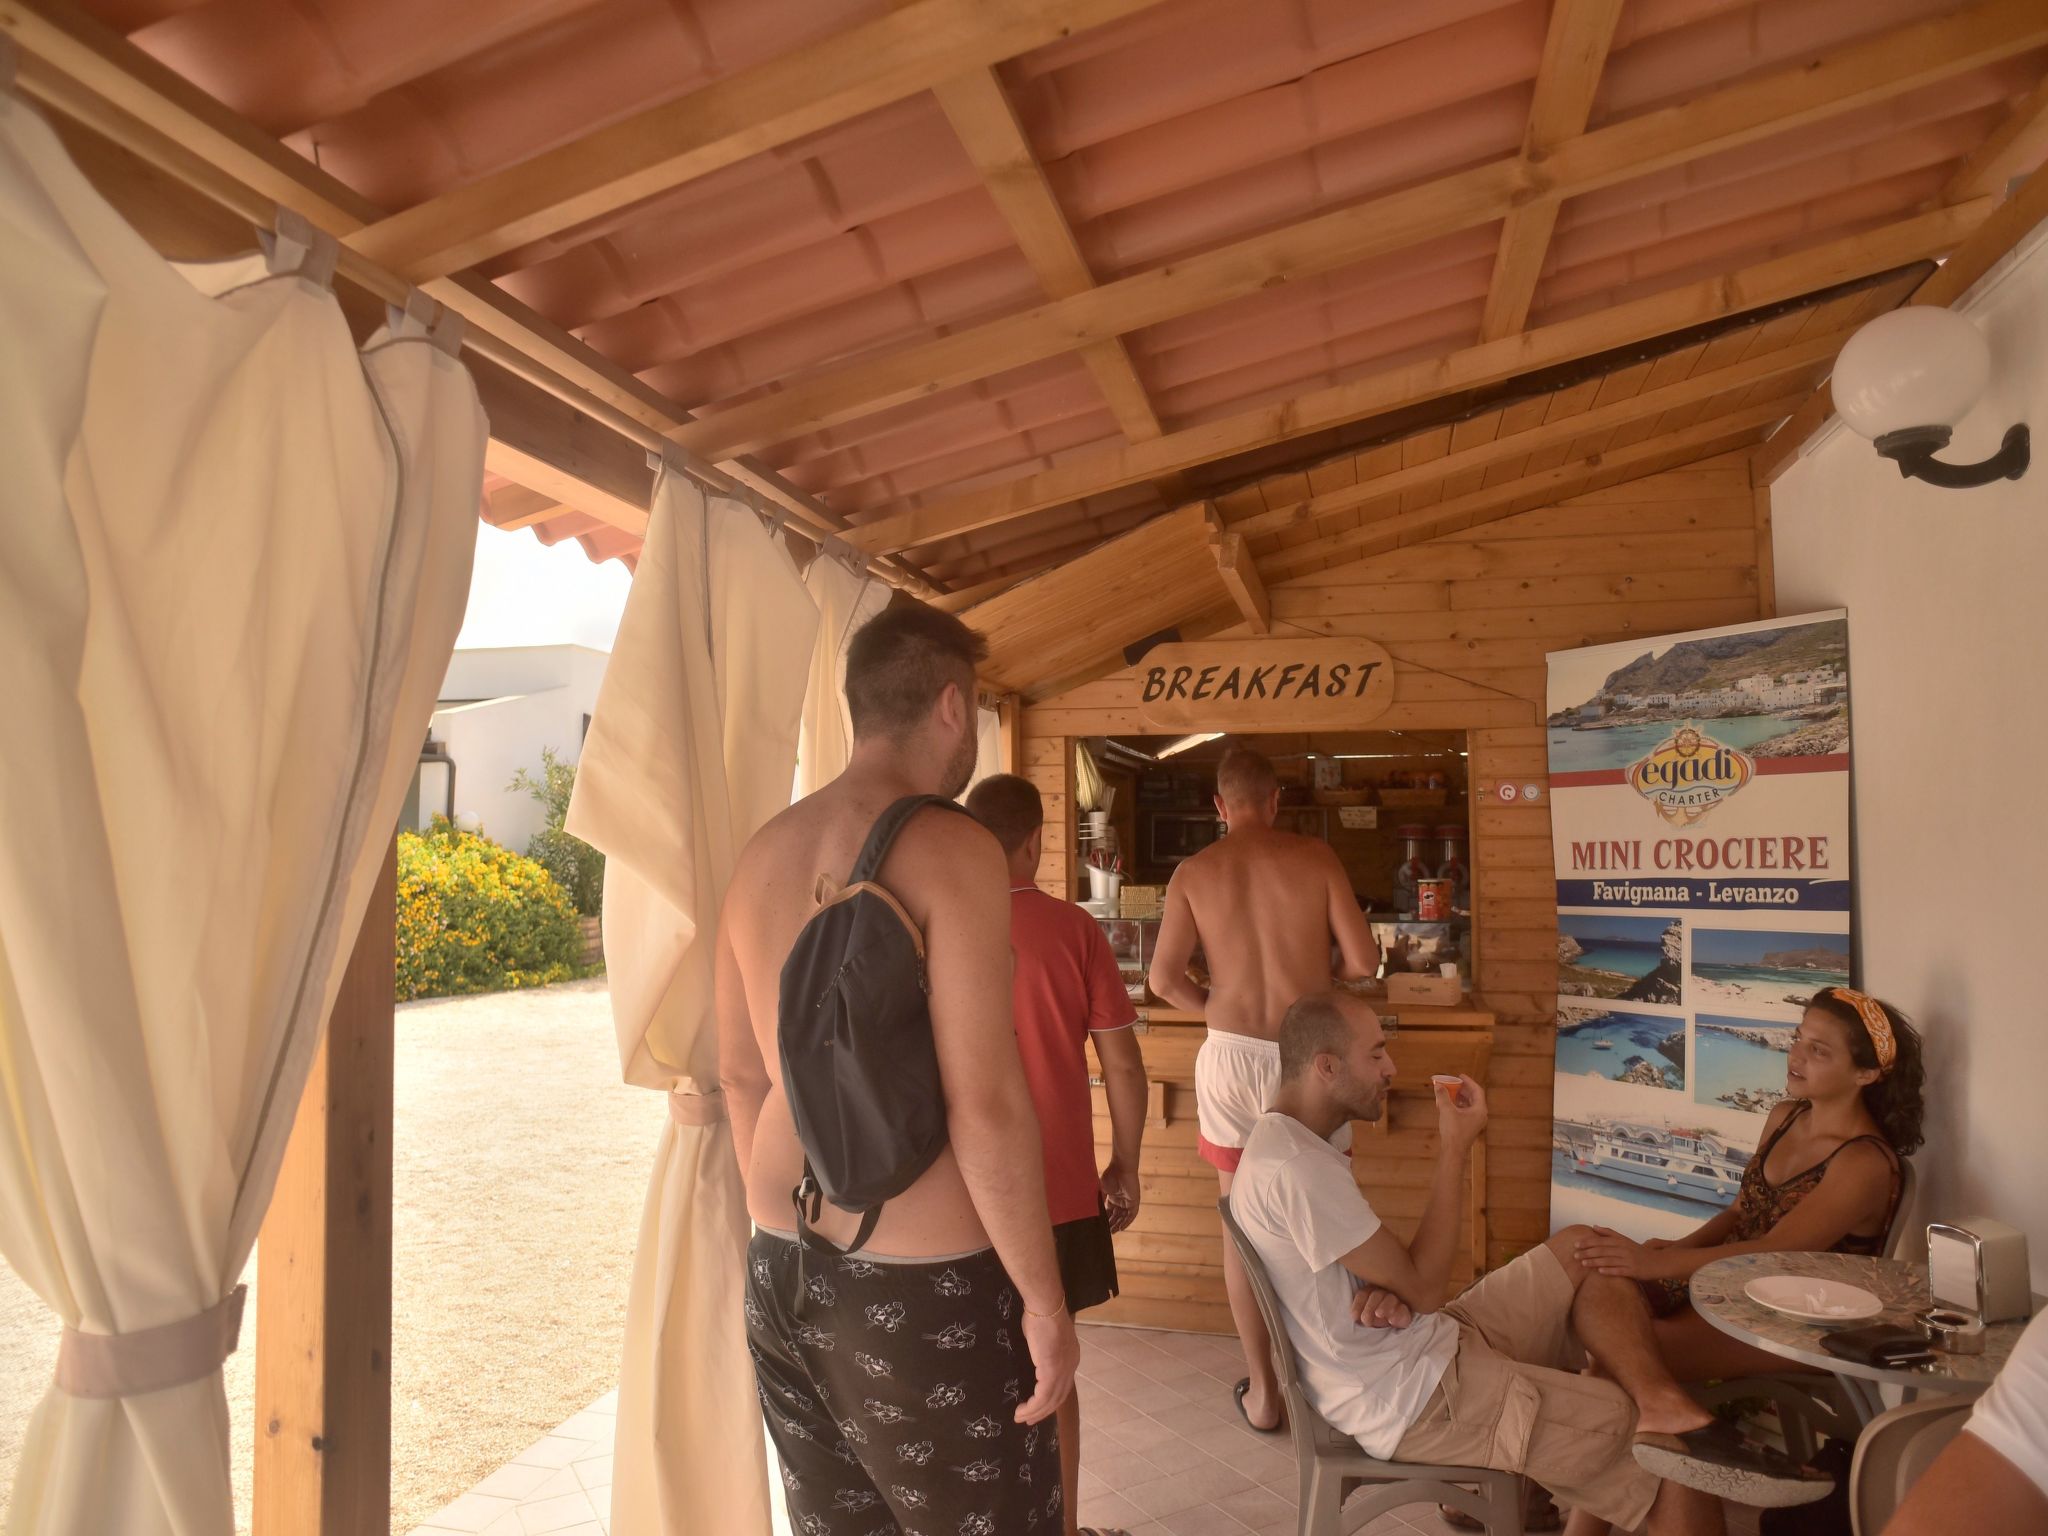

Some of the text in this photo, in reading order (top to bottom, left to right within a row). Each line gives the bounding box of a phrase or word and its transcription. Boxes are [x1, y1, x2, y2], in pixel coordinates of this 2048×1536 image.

[1142, 661, 1383, 703] BREAKFAST
[1641, 748, 1735, 789] egadi
[1658, 788, 1721, 805] CHARTER
[1571, 836, 1829, 871] MINI CROCIERE
[1593, 881, 1690, 906] Favignana
[1708, 881, 1799, 904] Levanzo
